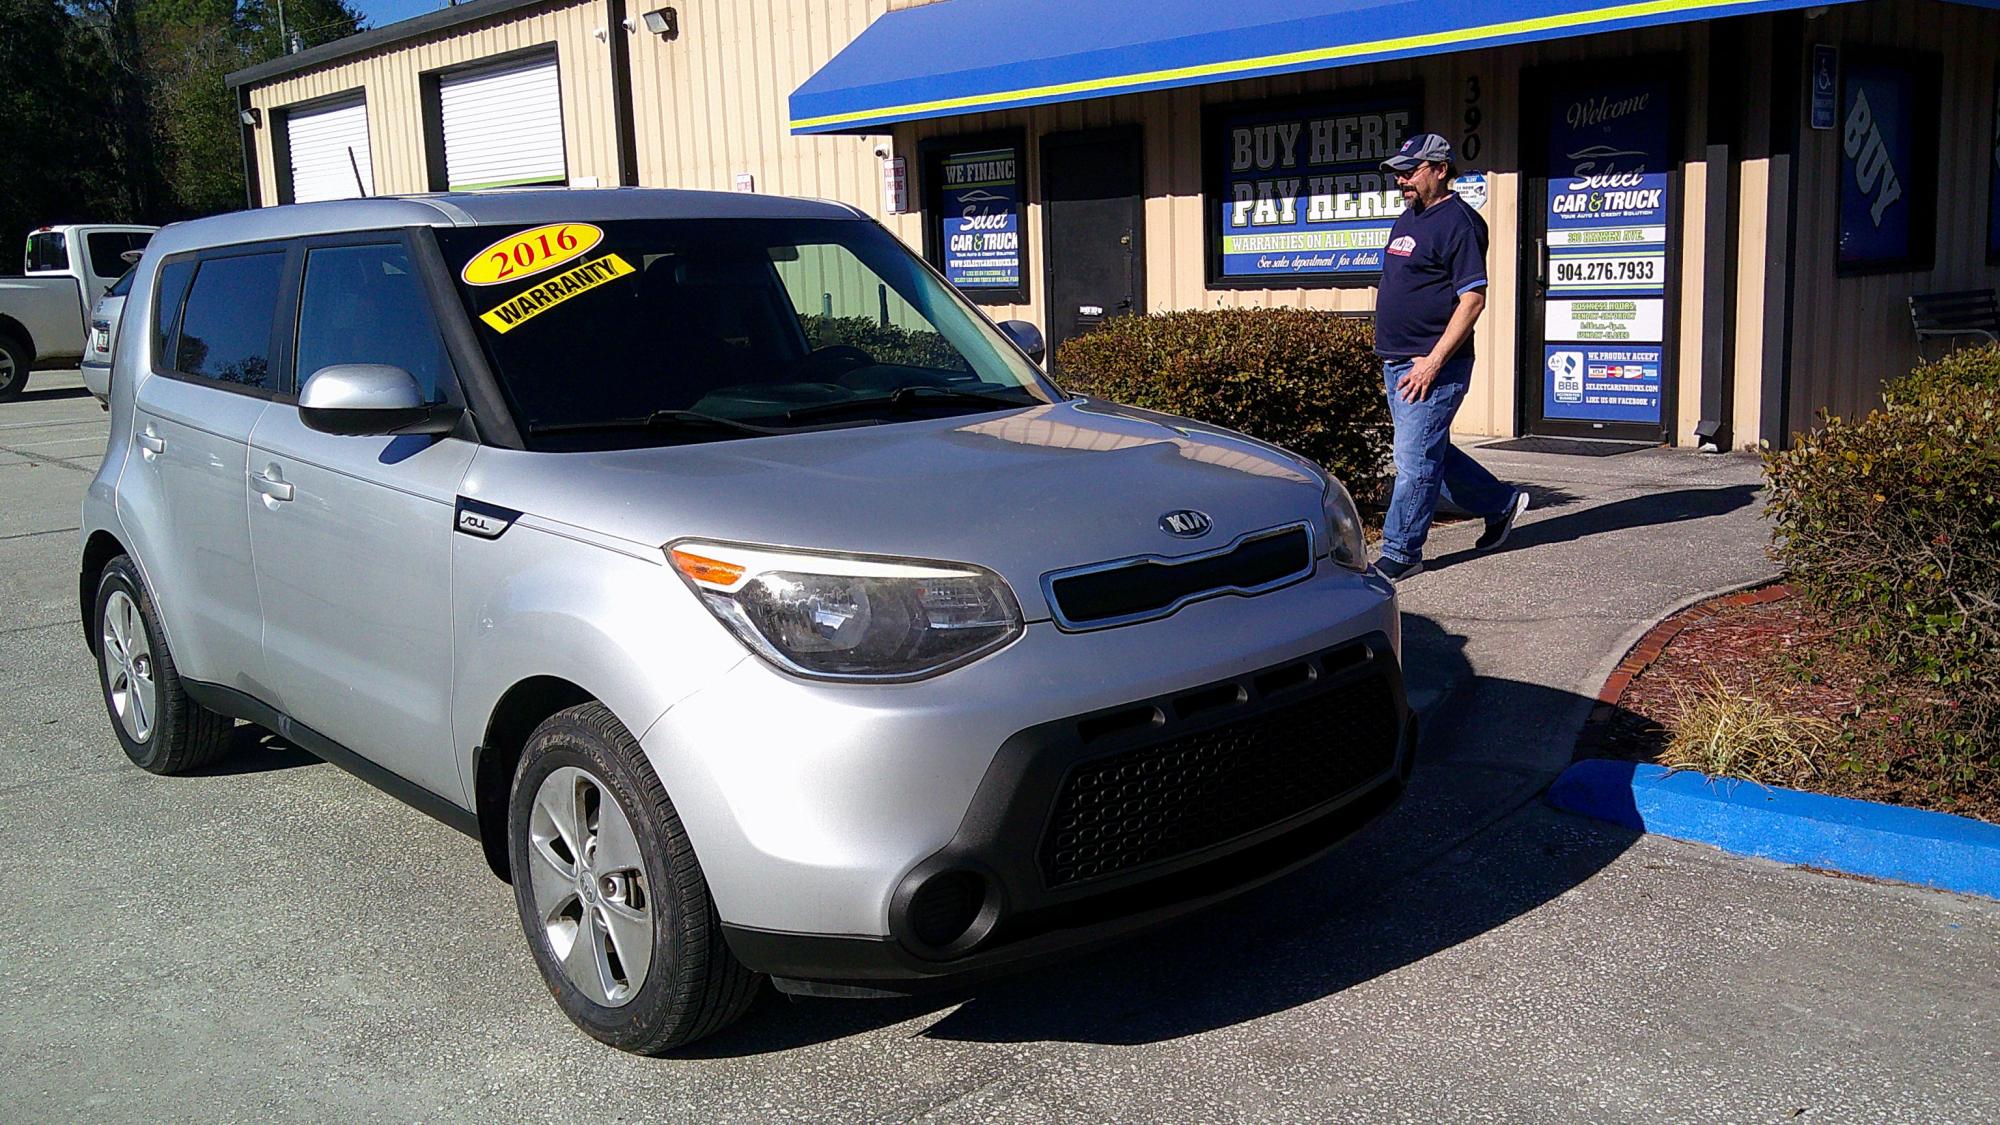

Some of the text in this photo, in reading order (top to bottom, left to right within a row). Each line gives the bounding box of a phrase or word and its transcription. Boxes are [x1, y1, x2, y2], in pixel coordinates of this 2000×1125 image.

[1566, 93, 1649, 131] Welcome
[1232, 111, 1409, 172] BUY HERE
[1844, 87, 1902, 227] BUY
[945, 163, 964, 185] WE
[1568, 161, 1645, 191] Select
[1232, 172, 1406, 227] PAY HERE
[1553, 189, 1663, 213] CAR & TRUCK
[960, 205, 1010, 231] Select
[1623, 209, 1653, 217] SOLUTION
[490, 225, 578, 279] 2016
[950, 232, 1019, 252] CAR & TRUCK
[1232, 233, 1304, 252] WARRANTIES
[1306, 233, 1323, 249] ON
[1324, 232, 1348, 248] ALL
[1257, 255, 1272, 269] See
[1272, 255, 1289, 268] sales
[1291, 253, 1334, 272] department
[1334, 252, 1351, 271] for
[1557, 260, 1655, 282] 904.276.7933
[493, 257, 618, 326] WARRANTY
[1587, 352, 1659, 362] WE PROUDLY ACCEPT
[1558, 381, 1580, 391] BBB
[1165, 512, 1208, 533] KIA
